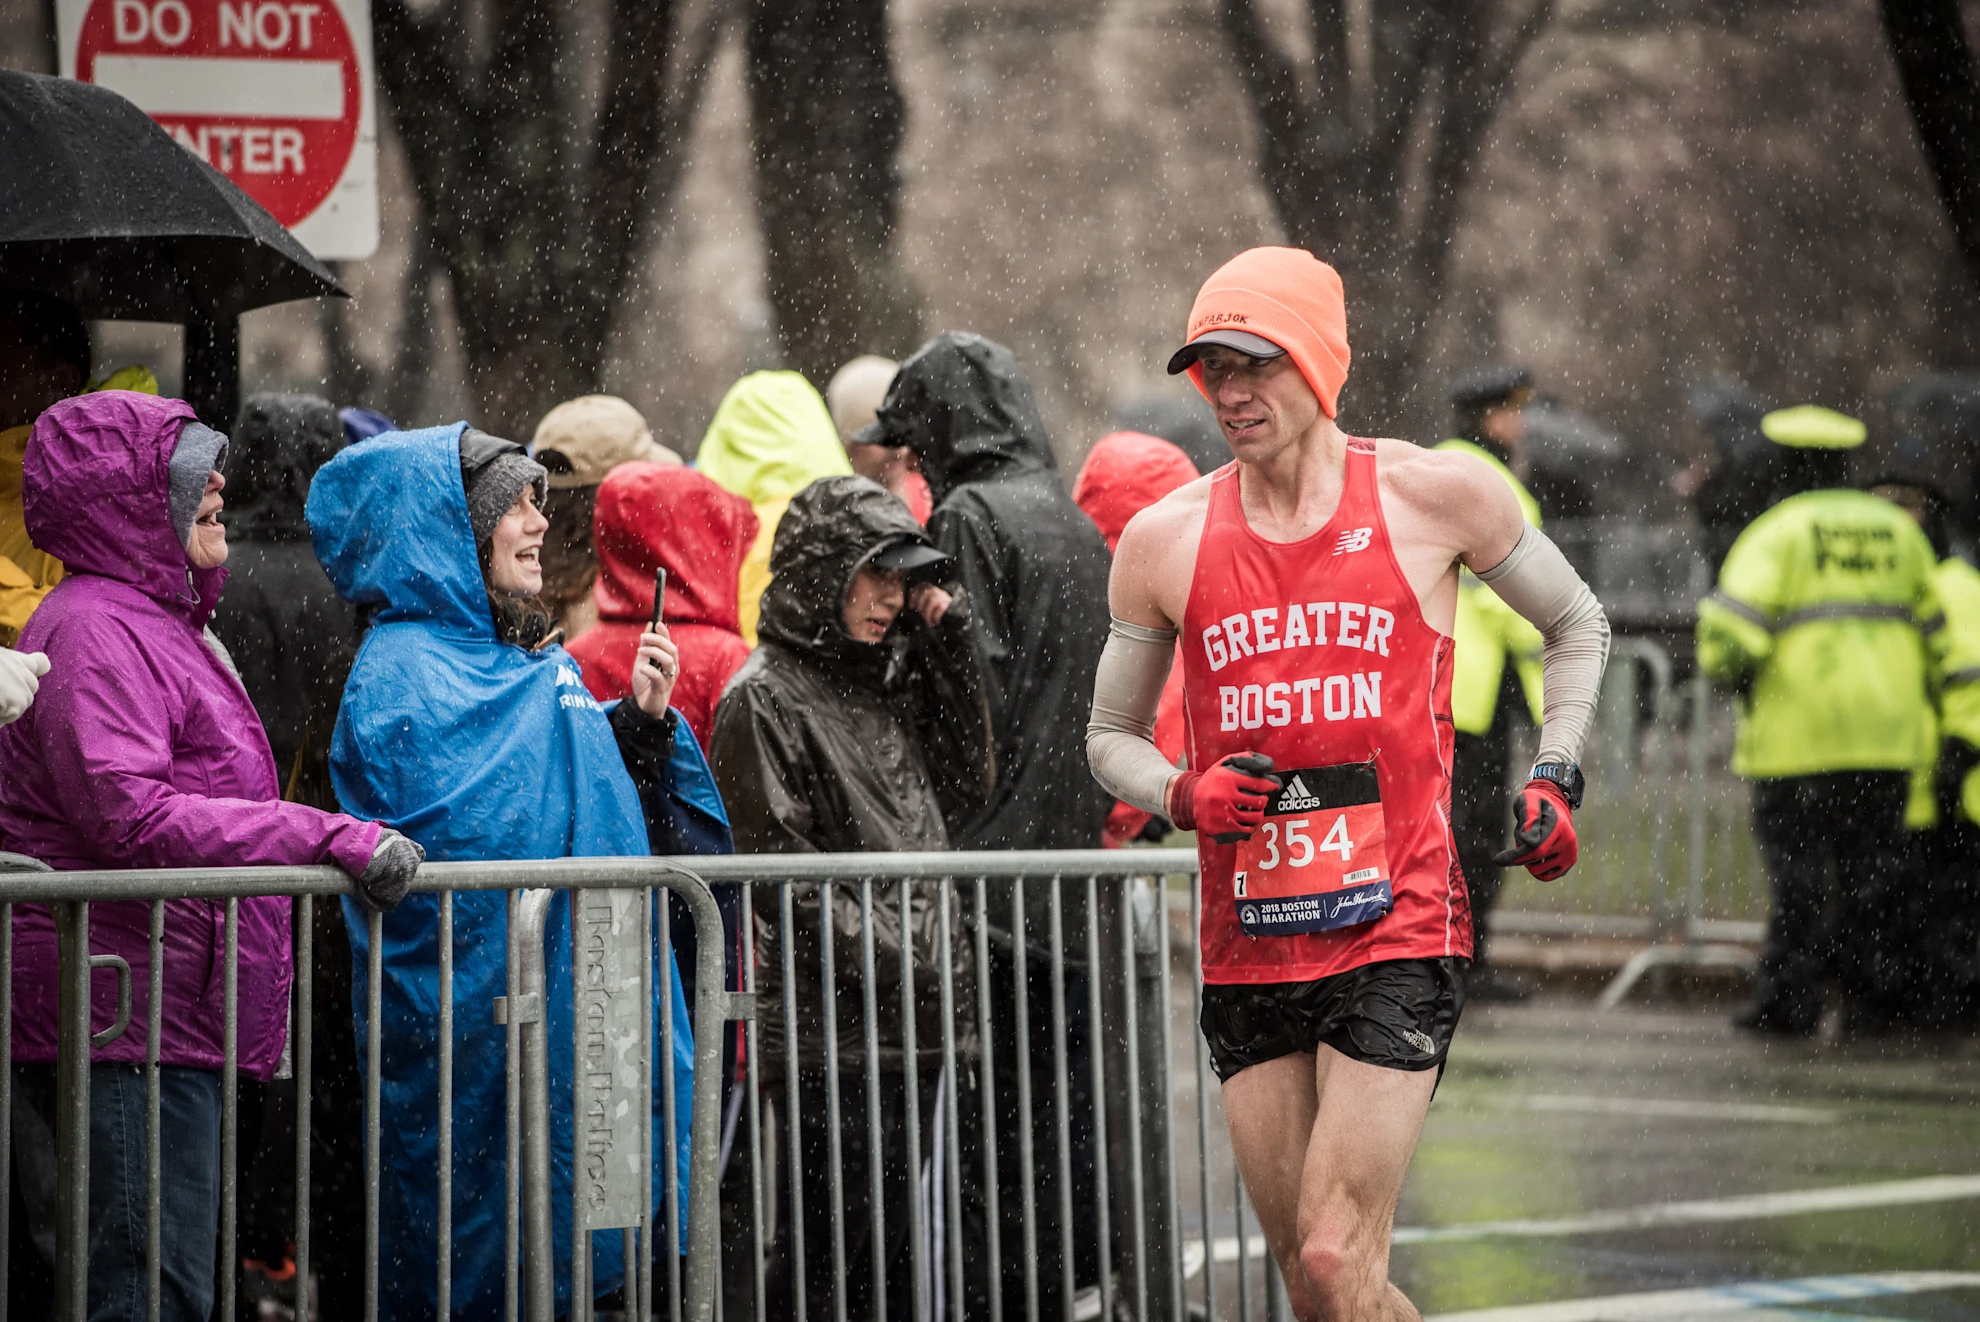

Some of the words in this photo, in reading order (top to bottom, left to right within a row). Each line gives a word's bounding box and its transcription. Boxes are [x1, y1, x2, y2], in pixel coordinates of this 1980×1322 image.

[115, 0, 192, 46] DO
[218, 2, 320, 49] NOT
[160, 125, 305, 174] NTER
[1202, 602, 1395, 672] GREATER
[1219, 671, 1382, 731] BOSTON
[1277, 796, 1321, 811] adidas
[1258, 814, 1354, 870] 354
[1260, 903, 1280, 914] 2018
[1281, 899, 1319, 912] BOSTON
[1261, 909, 1320, 924] MARATHON
